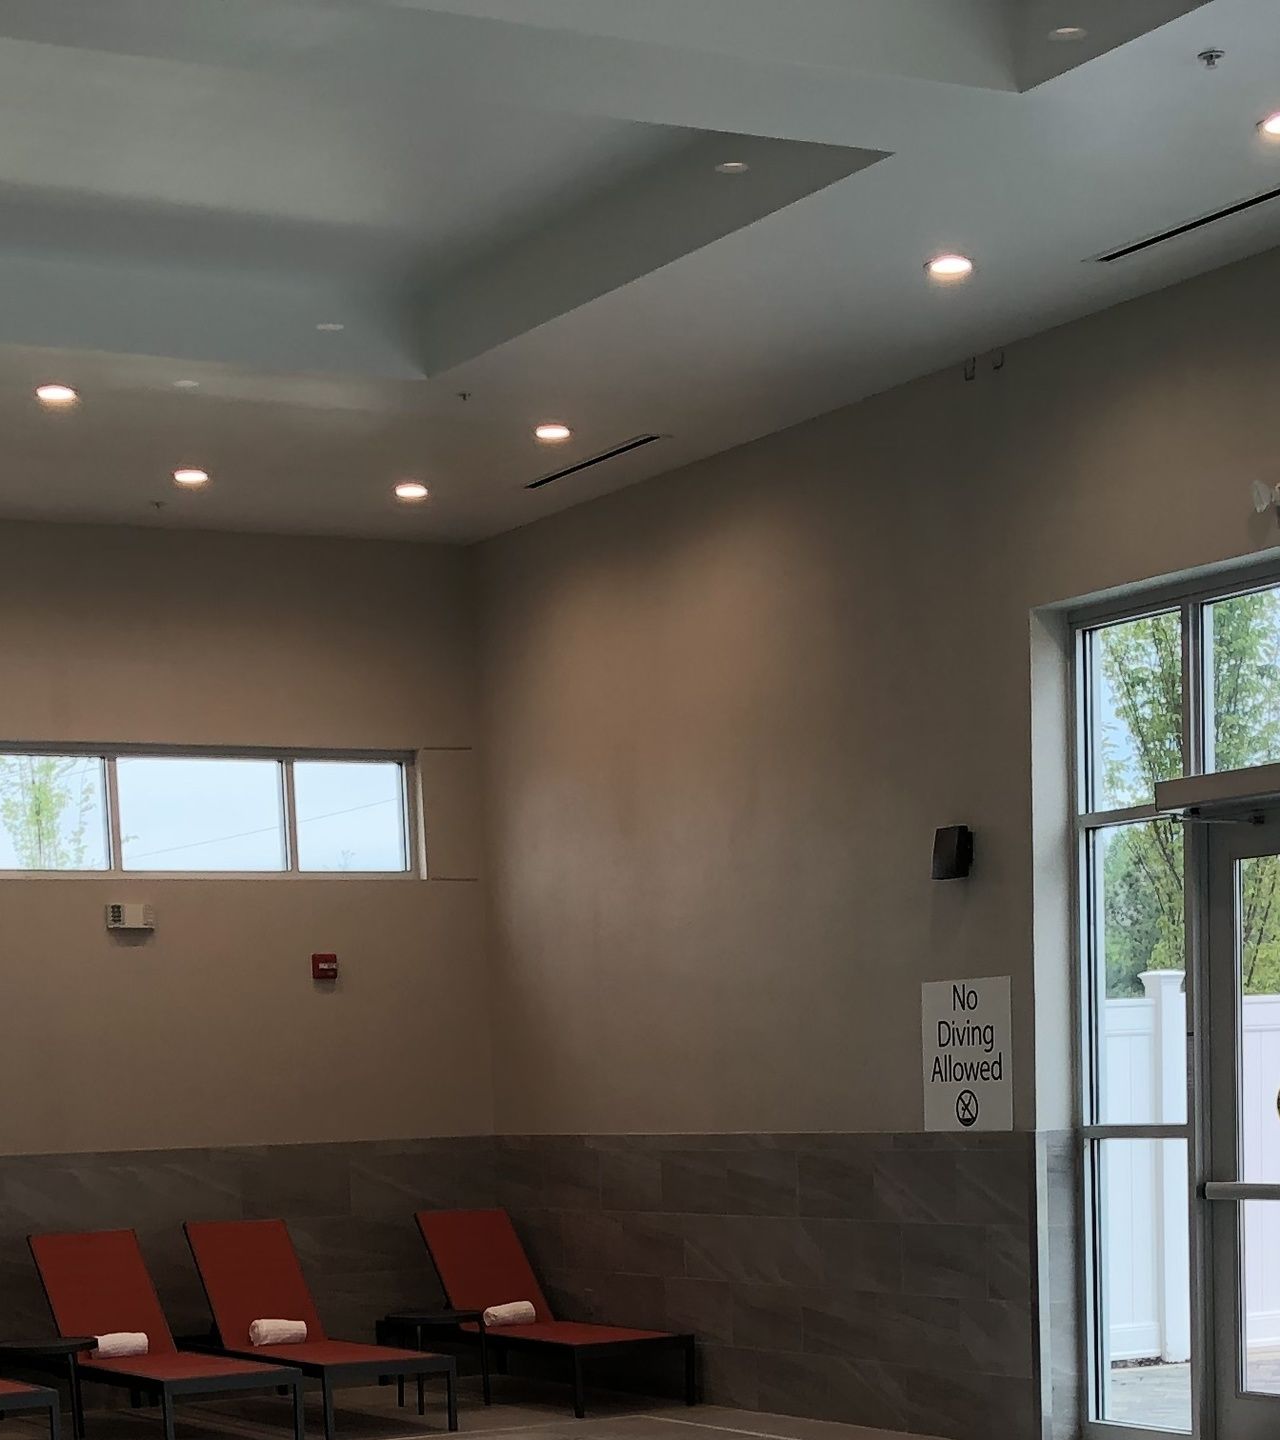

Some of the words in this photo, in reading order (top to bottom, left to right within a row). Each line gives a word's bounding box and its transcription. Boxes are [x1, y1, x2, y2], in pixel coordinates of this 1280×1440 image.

[952, 983, 978, 1011] No
[937, 1019, 994, 1053] Diving
[931, 1051, 1003, 1083] Allowed
